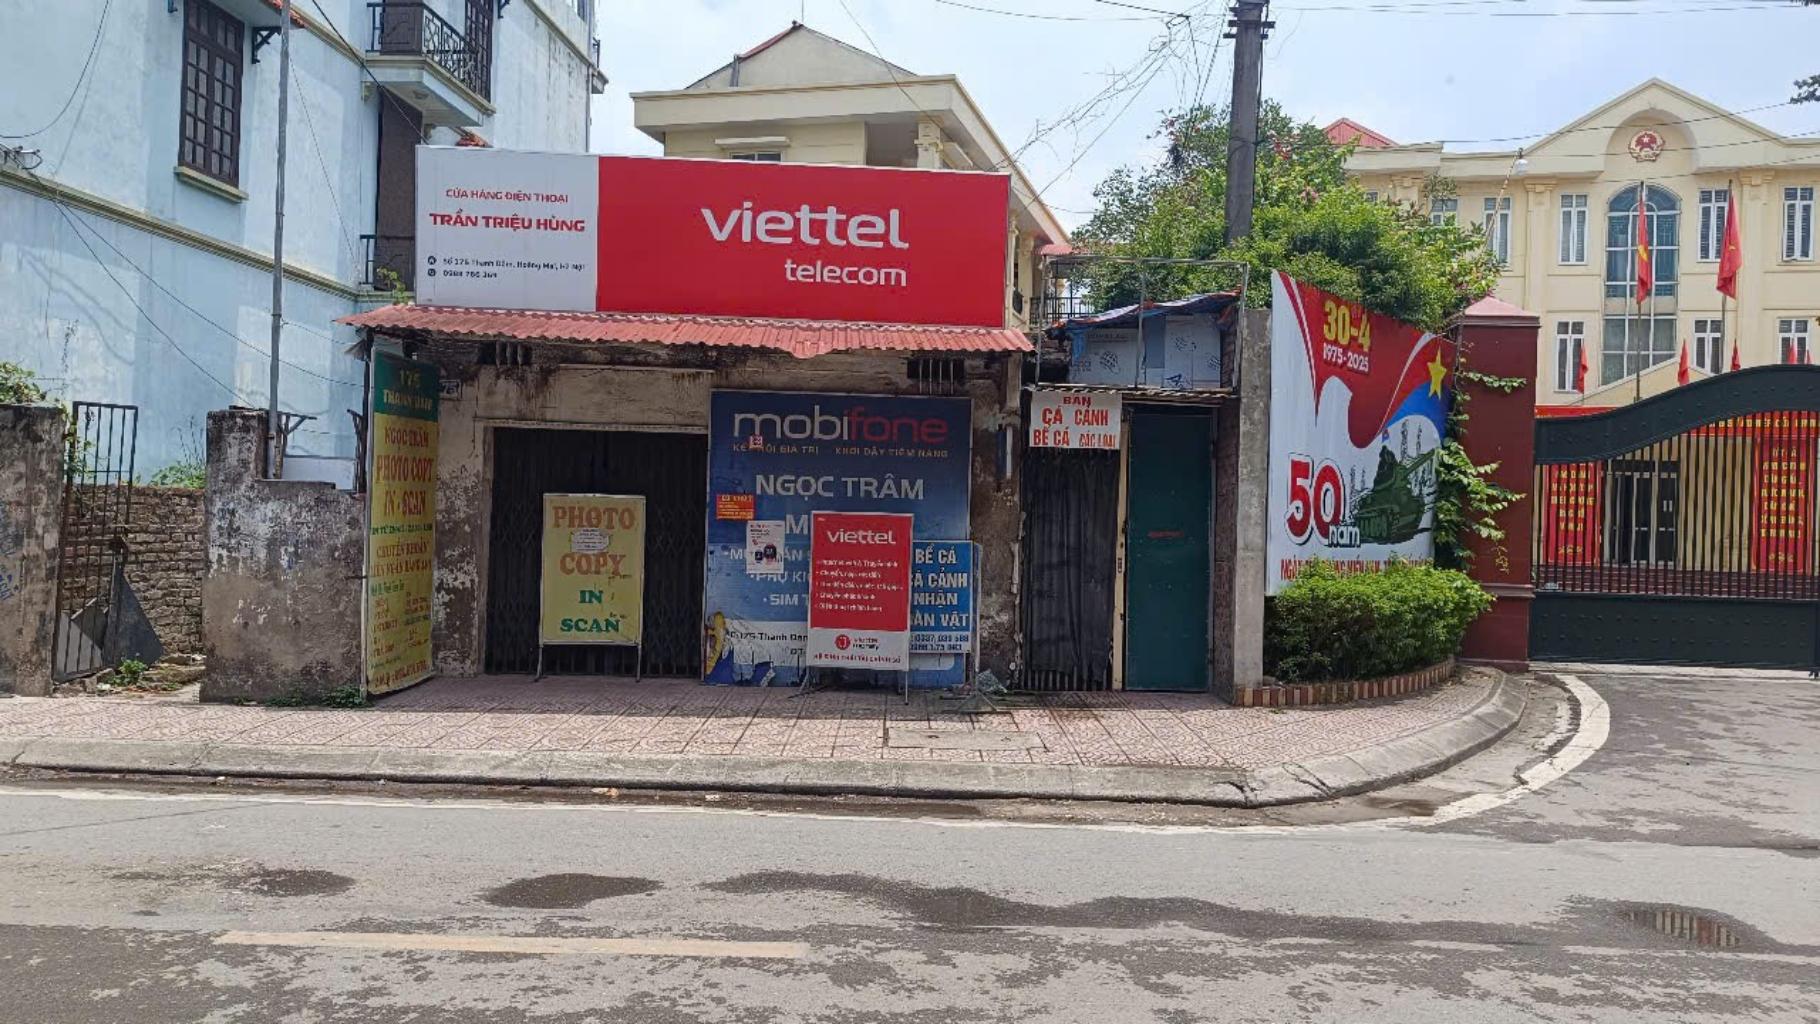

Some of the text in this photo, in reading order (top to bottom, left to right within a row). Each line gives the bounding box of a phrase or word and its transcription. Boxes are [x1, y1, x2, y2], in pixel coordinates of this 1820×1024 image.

[505, 190, 531, 203] ĐIỆN
[534, 192, 568, 205] THOẠI
[429, 208, 585, 232] TRẦN TRIỆU HÙNG
[701, 202, 909, 249] viettel
[784, 259, 907, 286] telecom
[1323, 300, 1371, 352] 30-4
[734, 405, 948, 443] mobifone
[1053, 426, 1070, 446] CÁ
[756, 473, 924, 501] NGỌC TRÂM
[1286, 459, 1343, 539] 50
[552, 505, 636, 530] PHOTO
[827, 528, 896, 545] viettel
[1328, 519, 1361, 548] năm
[560, 553, 627, 577] COPY
[915, 543, 956, 564] BỂ CÁ
[928, 567, 968, 588] CẢNH
[579, 590, 604, 604] IN
[770, 594, 799, 606] SIM
[914, 590, 958, 608] NHẬN
[560, 618, 620, 633] SCAN
